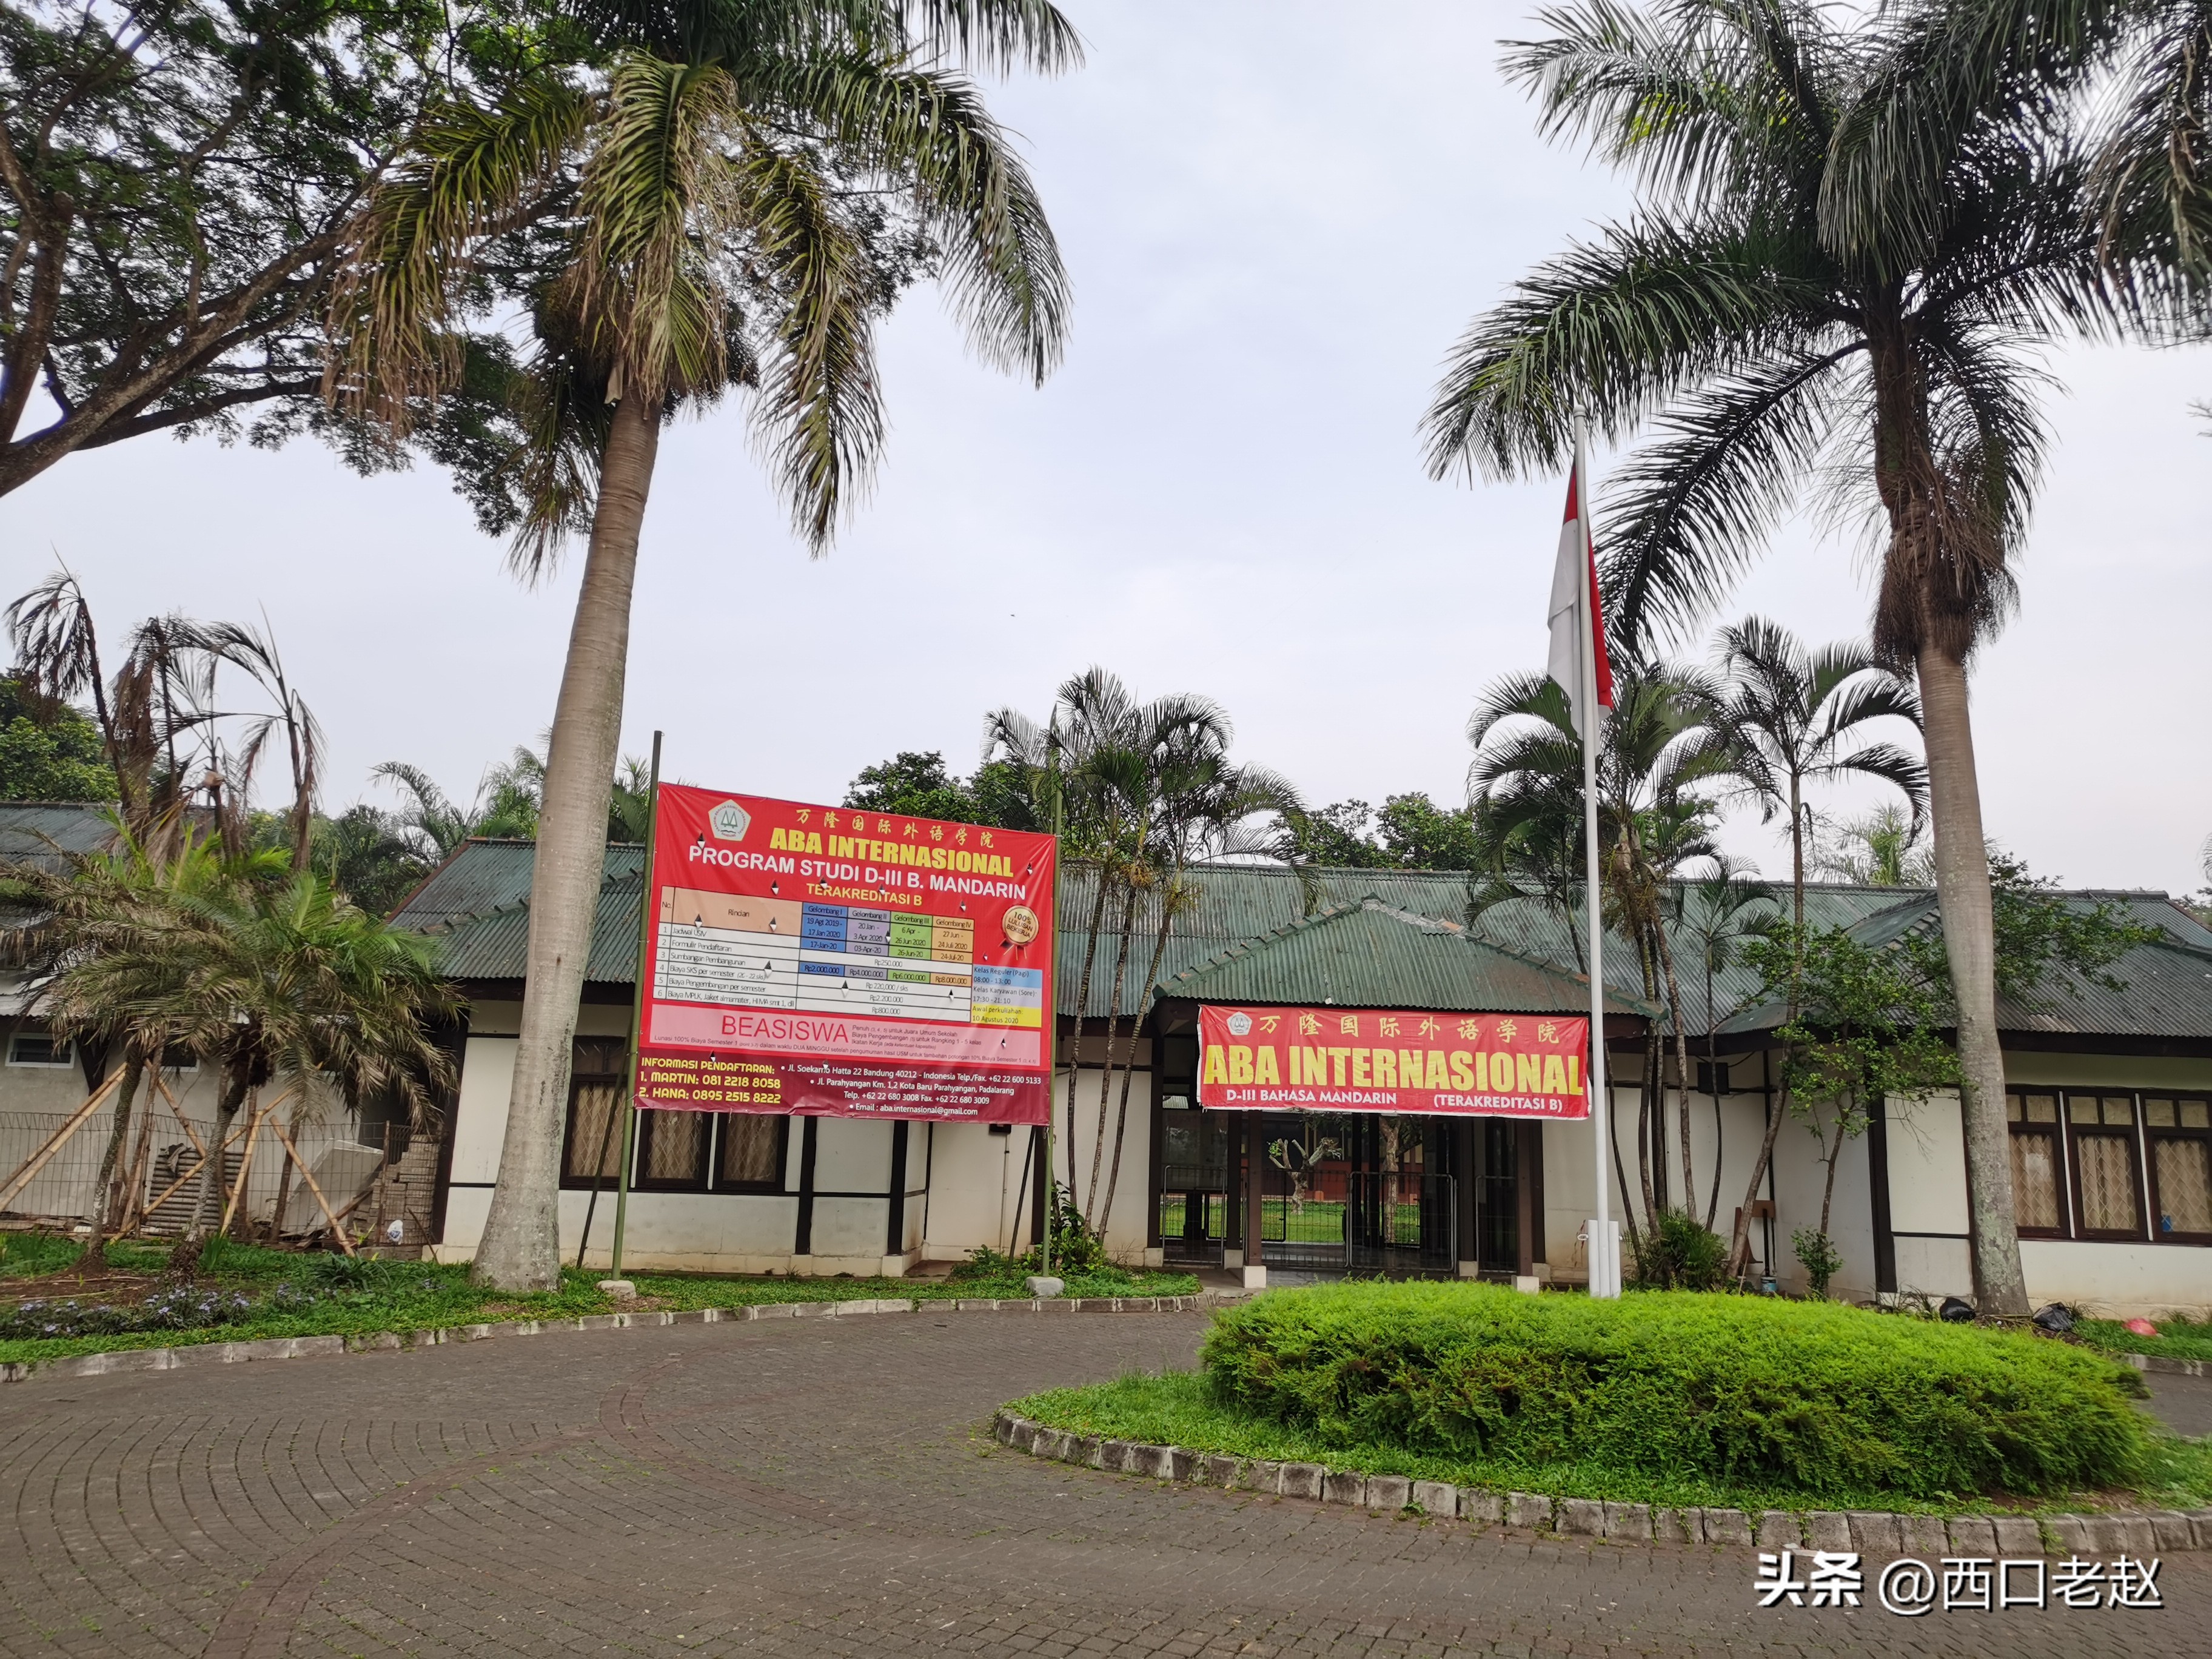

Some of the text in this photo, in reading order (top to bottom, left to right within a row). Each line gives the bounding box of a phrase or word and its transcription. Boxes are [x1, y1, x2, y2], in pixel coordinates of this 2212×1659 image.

[795, 806, 994, 850] 万隆国际外语学院
[769, 826, 1014, 877] ABA INTERNASIONAL
[689, 845, 1025, 900] PROGRAM STUDI D-III B. MANDARIN
[806, 882, 922, 906] TERAKREDITASI B
[728, 908, 749, 917] Rincian
[808, 905, 839, 915] Gelombang
[851, 910, 882, 920] Gelombang
[894, 914, 923, 924] Gelombang
[1014, 911, 1031, 925] 100%
[936, 919, 965, 928] Gelombang
[1008, 917, 1033, 931] LULUSAN
[1006, 925, 1031, 938] BEKERJA
[672, 940, 696, 948] Formulir
[697, 942, 731, 951] Pendaftaran
[810, 941, 837, 950] 17-Jan-20
[854, 945, 881, 954] 03-Apr-20
[897, 949, 923, 957] 26-Jun-20
[671, 953, 705, 962] Sumbangan
[705, 956, 745, 966] Pembangunan
[874, 959, 902, 968] Rp250.000
[669, 965, 685, 973] Biaya
[804, 965, 839, 974] Rp2.000.000
[850, 968, 883, 978] Rp4.000.000
[990, 968, 1011, 976] Reguler
[893, 973, 925, 982] Rp6.000.000
[935, 976, 967, 985] Rp8.000.000
[685, 979, 728, 990] Pengembangan
[668, 990, 683, 999] Biaya
[990, 987, 1017, 996] Karyawan
[870, 994, 903, 1004] Rp2.200.000
[980, 1016, 1003, 1024] Agustus
[721, 1015, 849, 1043] BEASISWA
[1259, 1013, 1560, 1044] 万隆国际外语学院
[641, 1057, 775, 1074] INFORMASI PENDAFTARAN:
[1203, 1045, 1583, 1096] ABA INTERNASIONAL
[863, 1068, 894, 1078] Bandung
[895, 1070, 916, 1078] 40212
[923, 1071, 955, 1080] Indonesia
[640, 1071, 781, 1088] 1. MARTIN: 081 2218 8058
[826, 1078, 870, 1089] Parahyangan
[888, 1081, 897, 1090] 1,2
[934, 1084, 977, 1094] Parahyangan,
[979, 1085, 1014, 1096] Padalarang
[638, 1087, 781, 1104] 2. HANA: 0895 2515 8222
[843, 1091, 859, 1100] Telp.
[1227, 1089, 1563, 1113] D-III BAHASA MANDARIN (TERAKREDITASI B)
